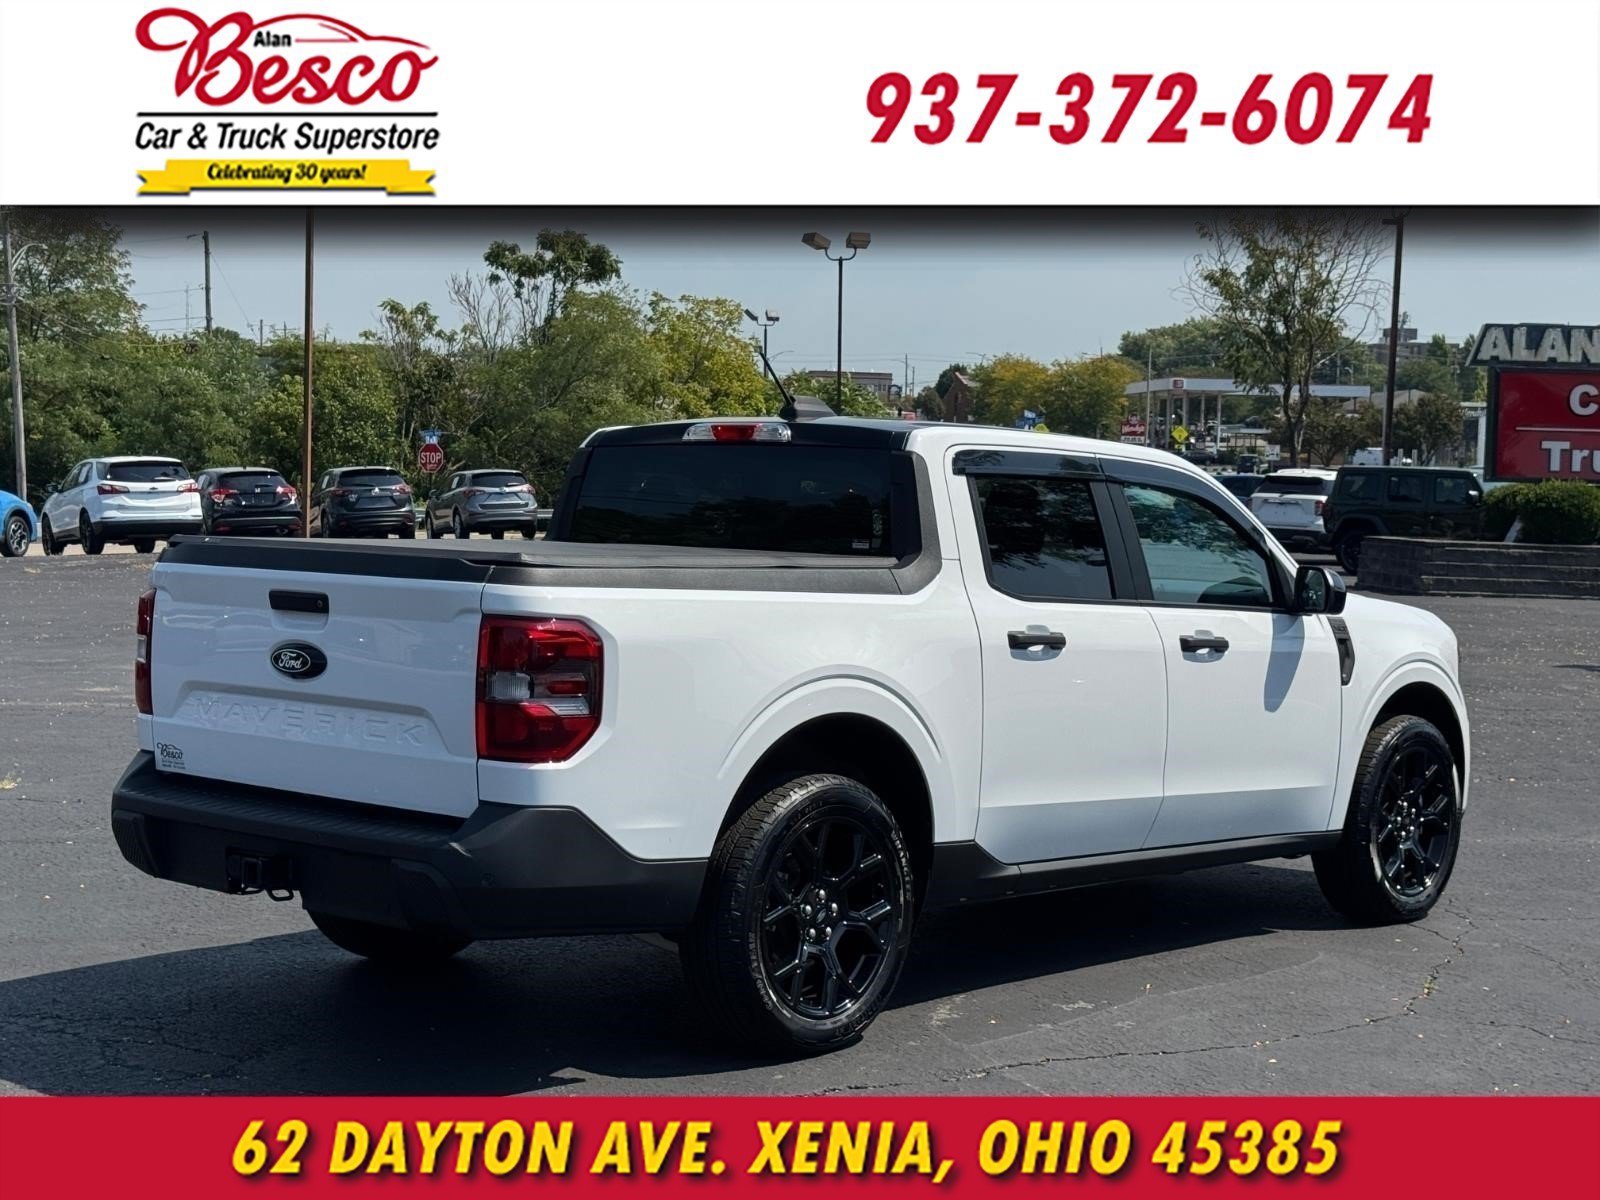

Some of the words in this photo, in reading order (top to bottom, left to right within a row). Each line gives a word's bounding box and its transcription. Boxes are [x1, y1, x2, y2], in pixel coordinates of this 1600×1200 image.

[1477, 326, 1600, 363] ALAN
[420, 452, 442, 464] STOP
[277, 650, 304, 670] Ford
[195, 696, 426, 747] MAVERICK
